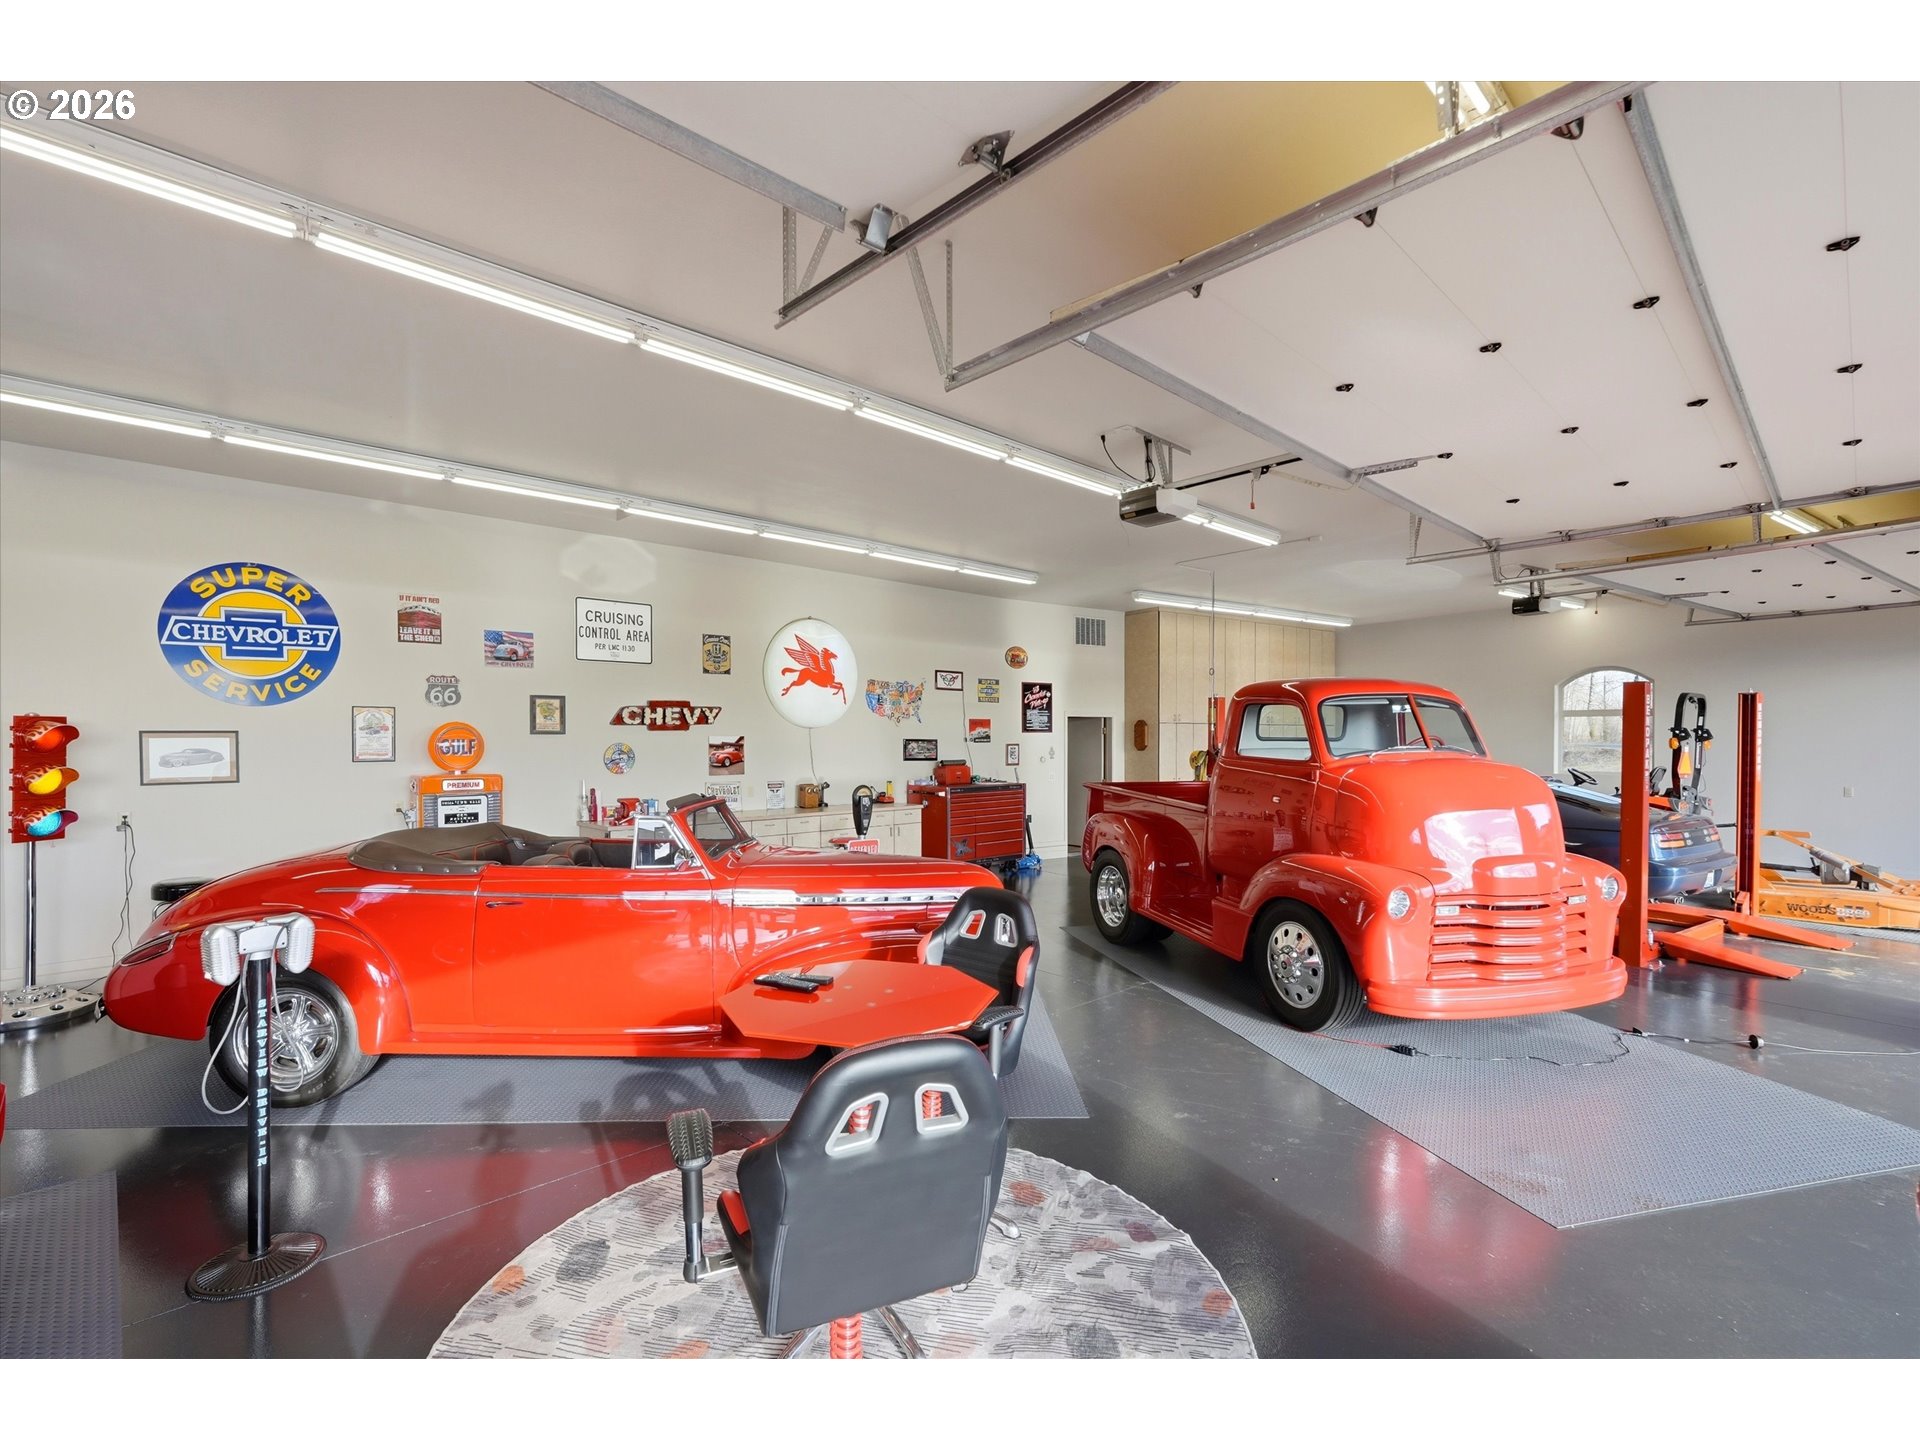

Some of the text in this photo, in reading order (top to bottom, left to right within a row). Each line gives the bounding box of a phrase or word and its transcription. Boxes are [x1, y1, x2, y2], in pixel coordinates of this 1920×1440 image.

[190, 567, 312, 606] SUPER
[585, 610, 644, 626] CRUISING
[171, 622, 331, 646] CHEVROLET
[578, 625, 650, 643] CONTROL AREA
[594, 642, 606, 650] PER
[183, 659, 322, 702] SERVICE
[429, 686, 457, 704] 66
[621, 706, 720, 725] CHEVY
[439, 739, 476, 756] GULF
[1786, 903, 1836, 915] WOODS
[256, 1088, 267, 1166] DRIVE-IN
